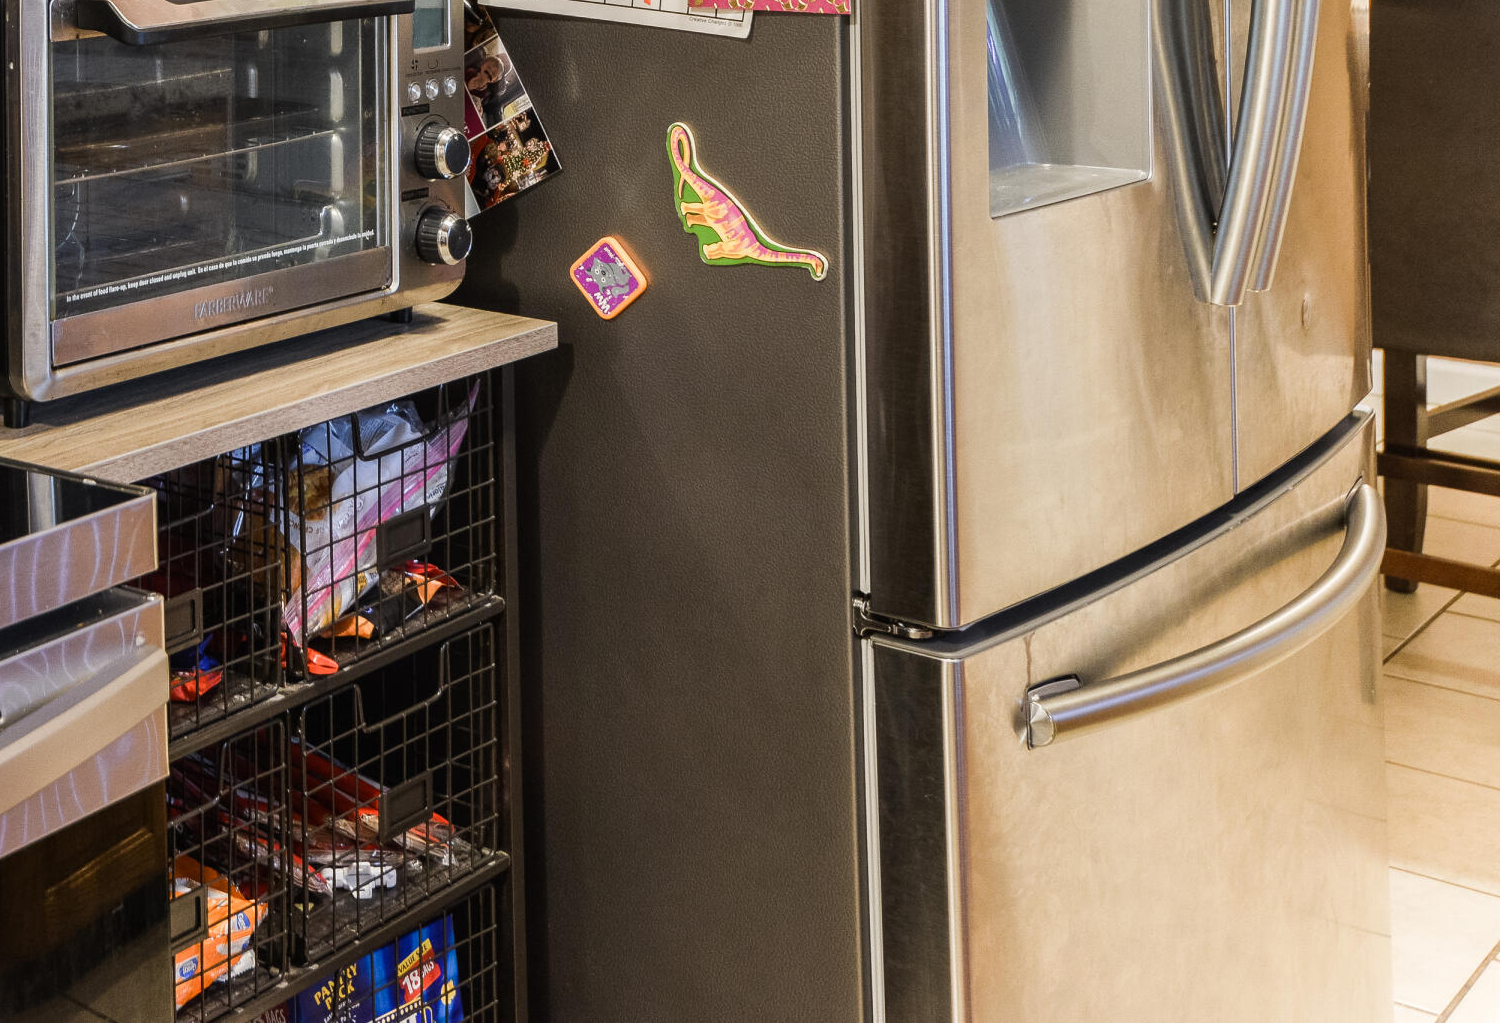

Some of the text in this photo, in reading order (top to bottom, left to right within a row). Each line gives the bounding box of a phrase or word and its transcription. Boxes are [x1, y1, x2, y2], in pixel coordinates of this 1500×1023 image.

[80, 290, 92, 299] event
[98, 286, 108, 295] food
[127, 279, 138, 290] keep
[139, 277, 148, 286] door
[149, 274, 163, 284] closed
[172, 269, 186, 280] unplug
[193, 287, 269, 321] FARBERWARE
[398, 951, 418, 973] VALUE
[402, 970, 420, 994] 18
